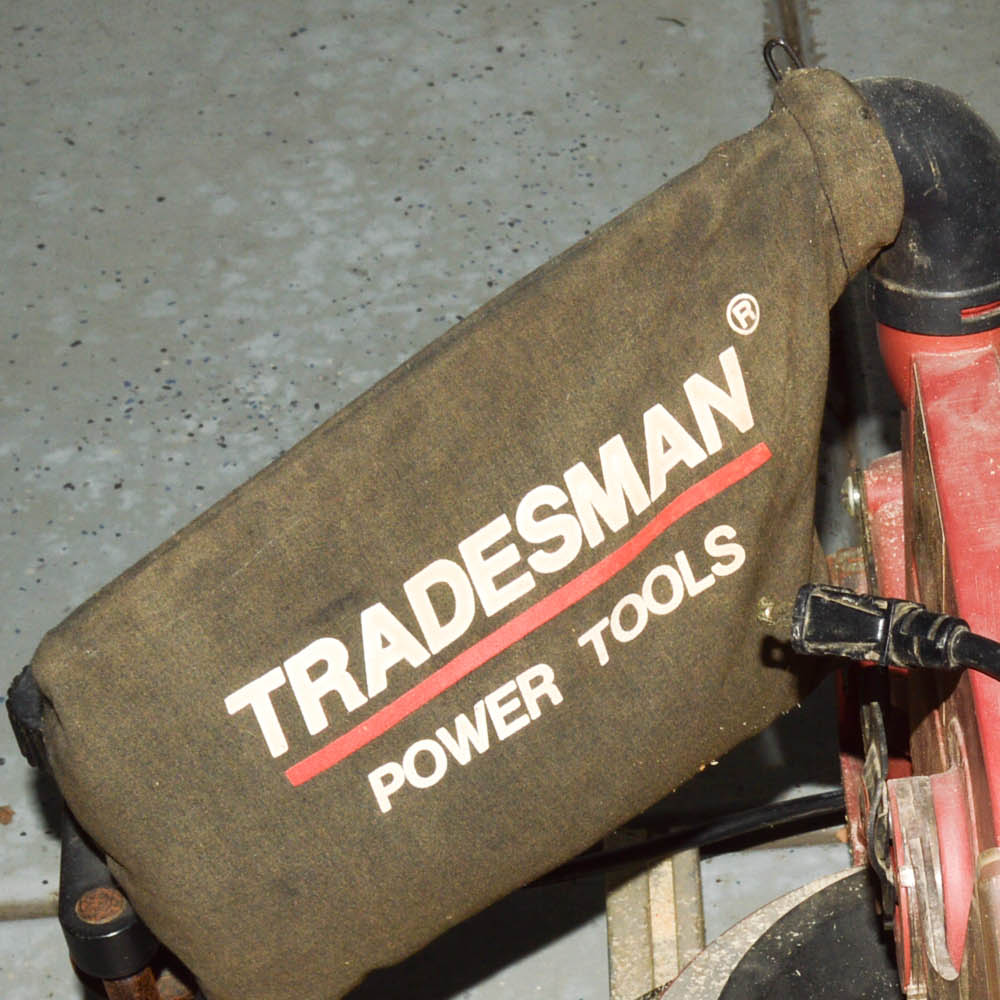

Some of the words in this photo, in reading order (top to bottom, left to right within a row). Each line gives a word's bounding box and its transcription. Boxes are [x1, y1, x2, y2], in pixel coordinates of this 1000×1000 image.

[224, 346, 755, 758] TRADESMAN
[367, 663, 564, 814] POWER
[578, 524, 746, 667] TOOLS
